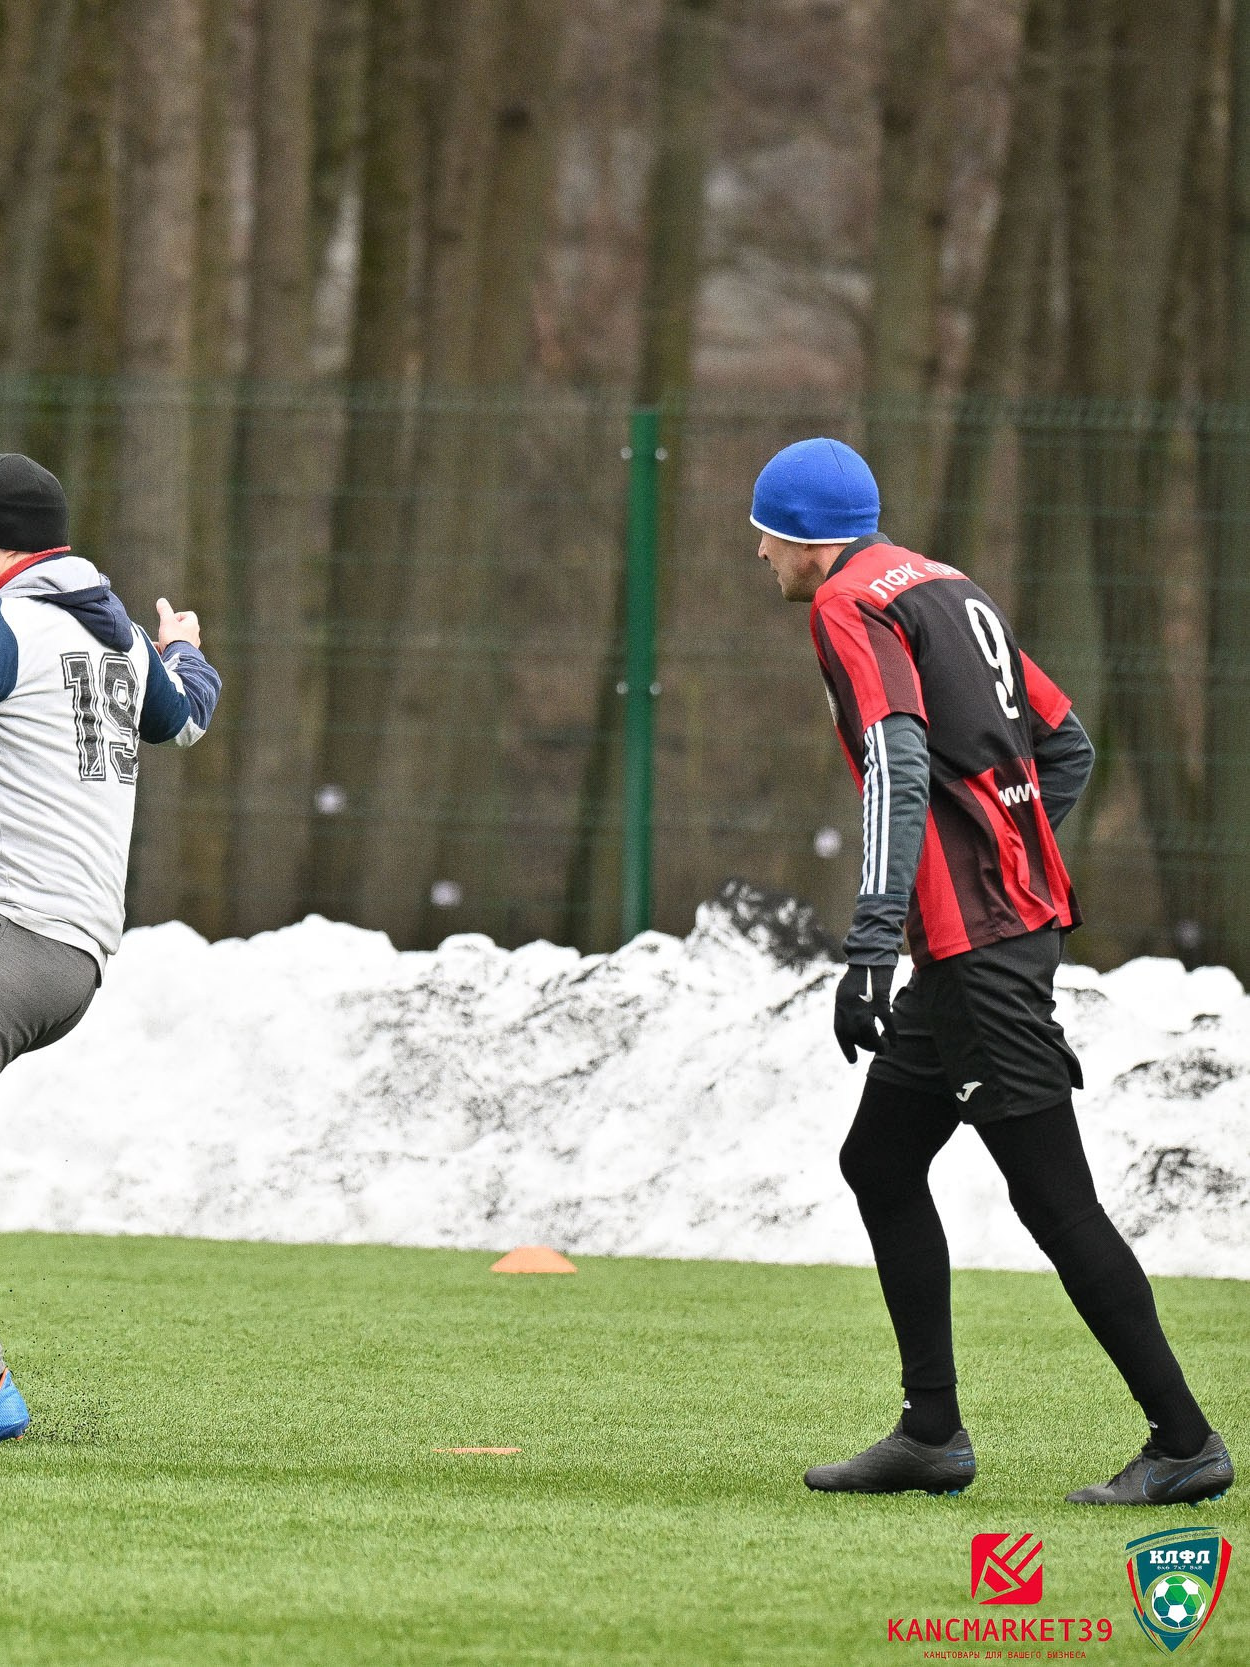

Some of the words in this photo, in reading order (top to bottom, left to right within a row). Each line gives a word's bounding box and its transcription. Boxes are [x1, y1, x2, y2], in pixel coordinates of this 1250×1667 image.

[868, 562, 927, 600] ЛФК
[59, 651, 140, 786] 19
[964, 598, 1020, 720] 9
